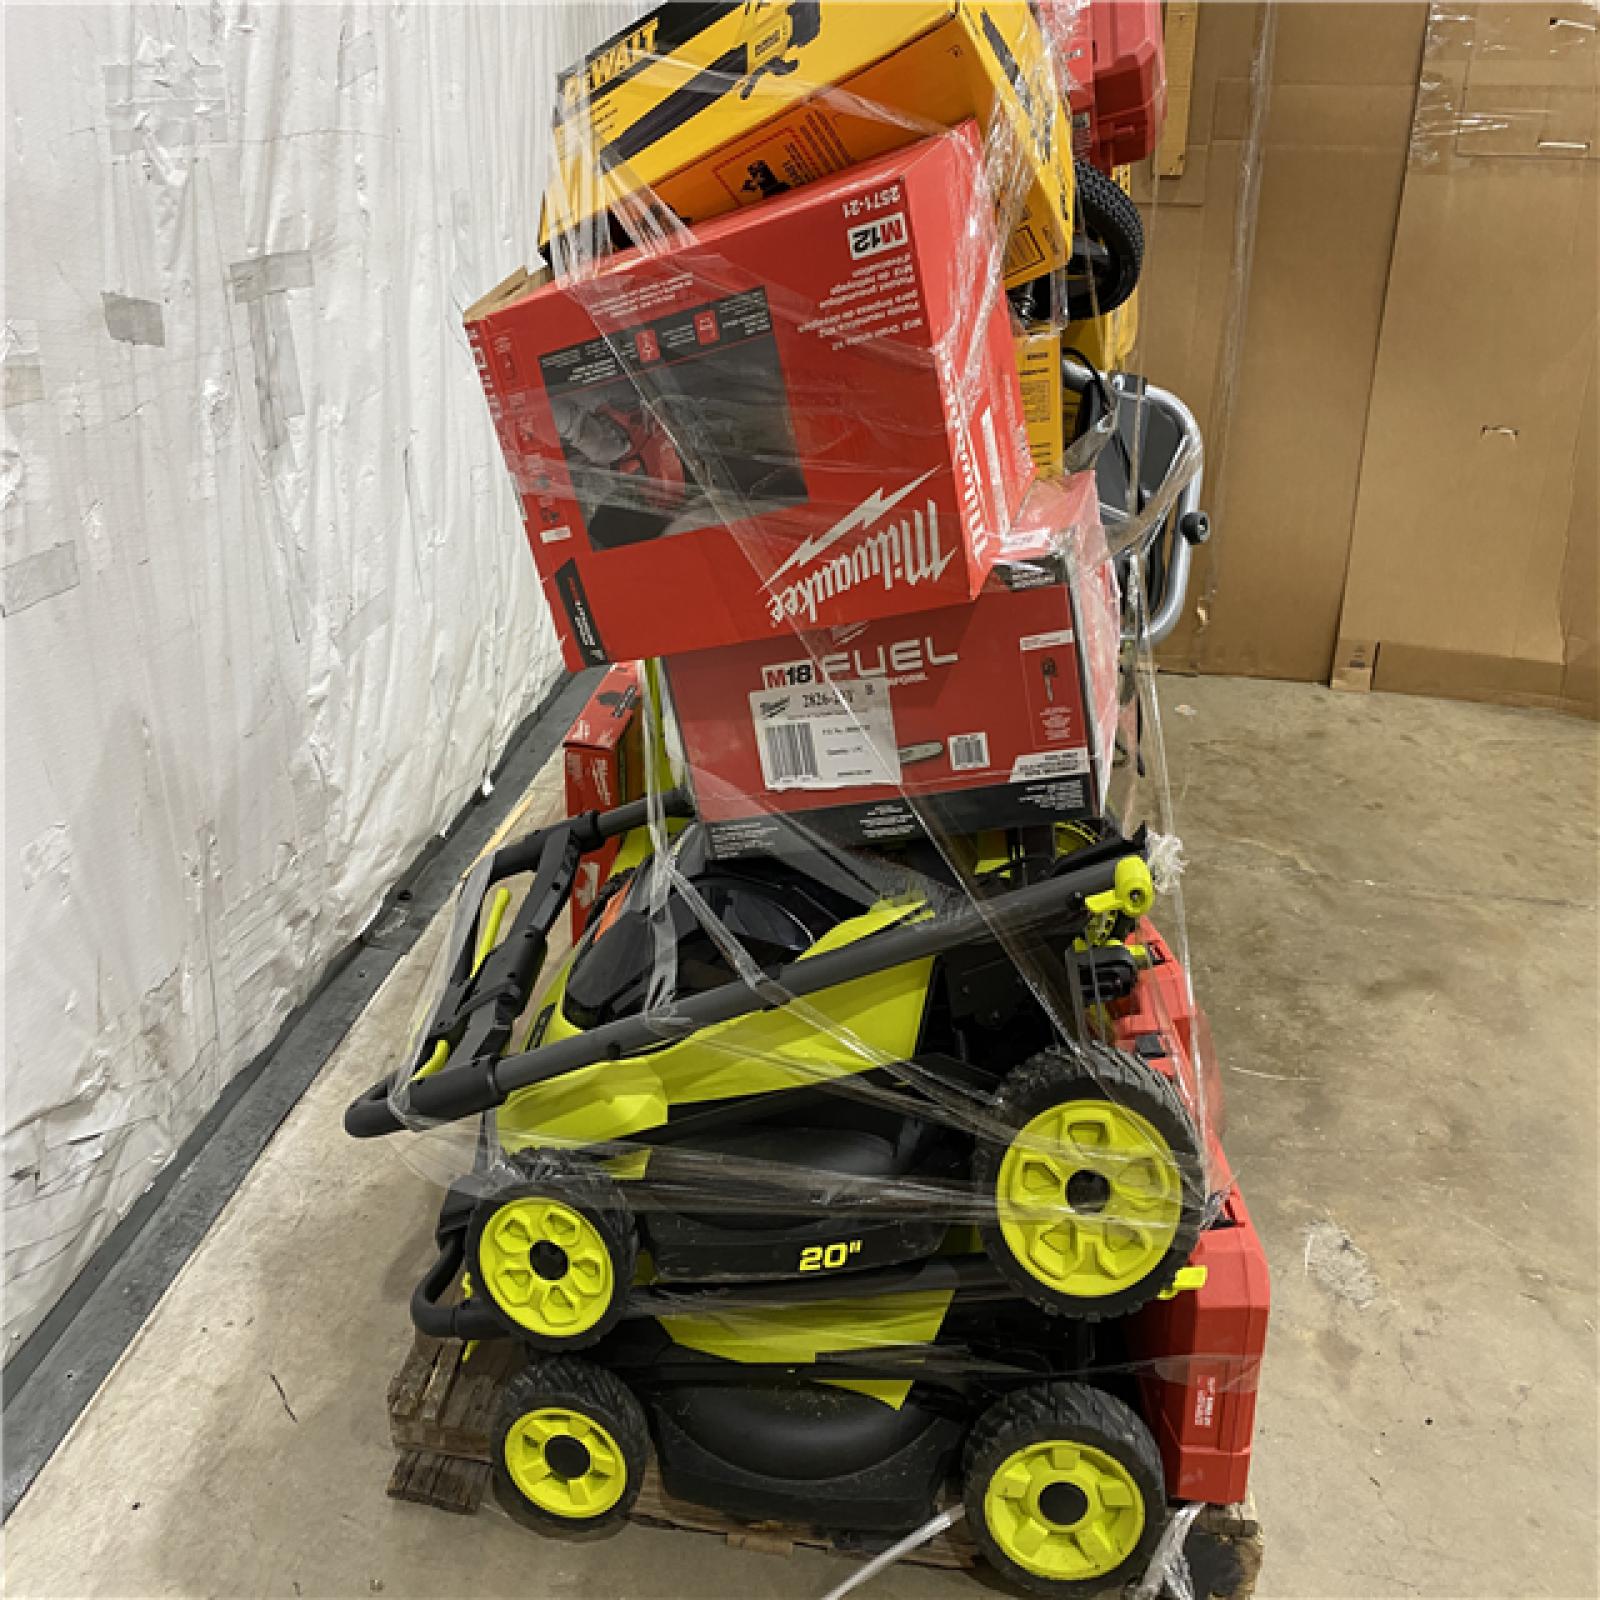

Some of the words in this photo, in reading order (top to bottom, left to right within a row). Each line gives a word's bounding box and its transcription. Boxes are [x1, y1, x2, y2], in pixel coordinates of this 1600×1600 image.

[842, 184, 901, 219] 2571-21
[851, 217, 905, 255] M12
[764, 498, 959, 624] Milwaukee
[766, 662, 813, 689] M18
[821, 636, 959, 684] FUEL
[799, 1239, 863, 1271] 20"
